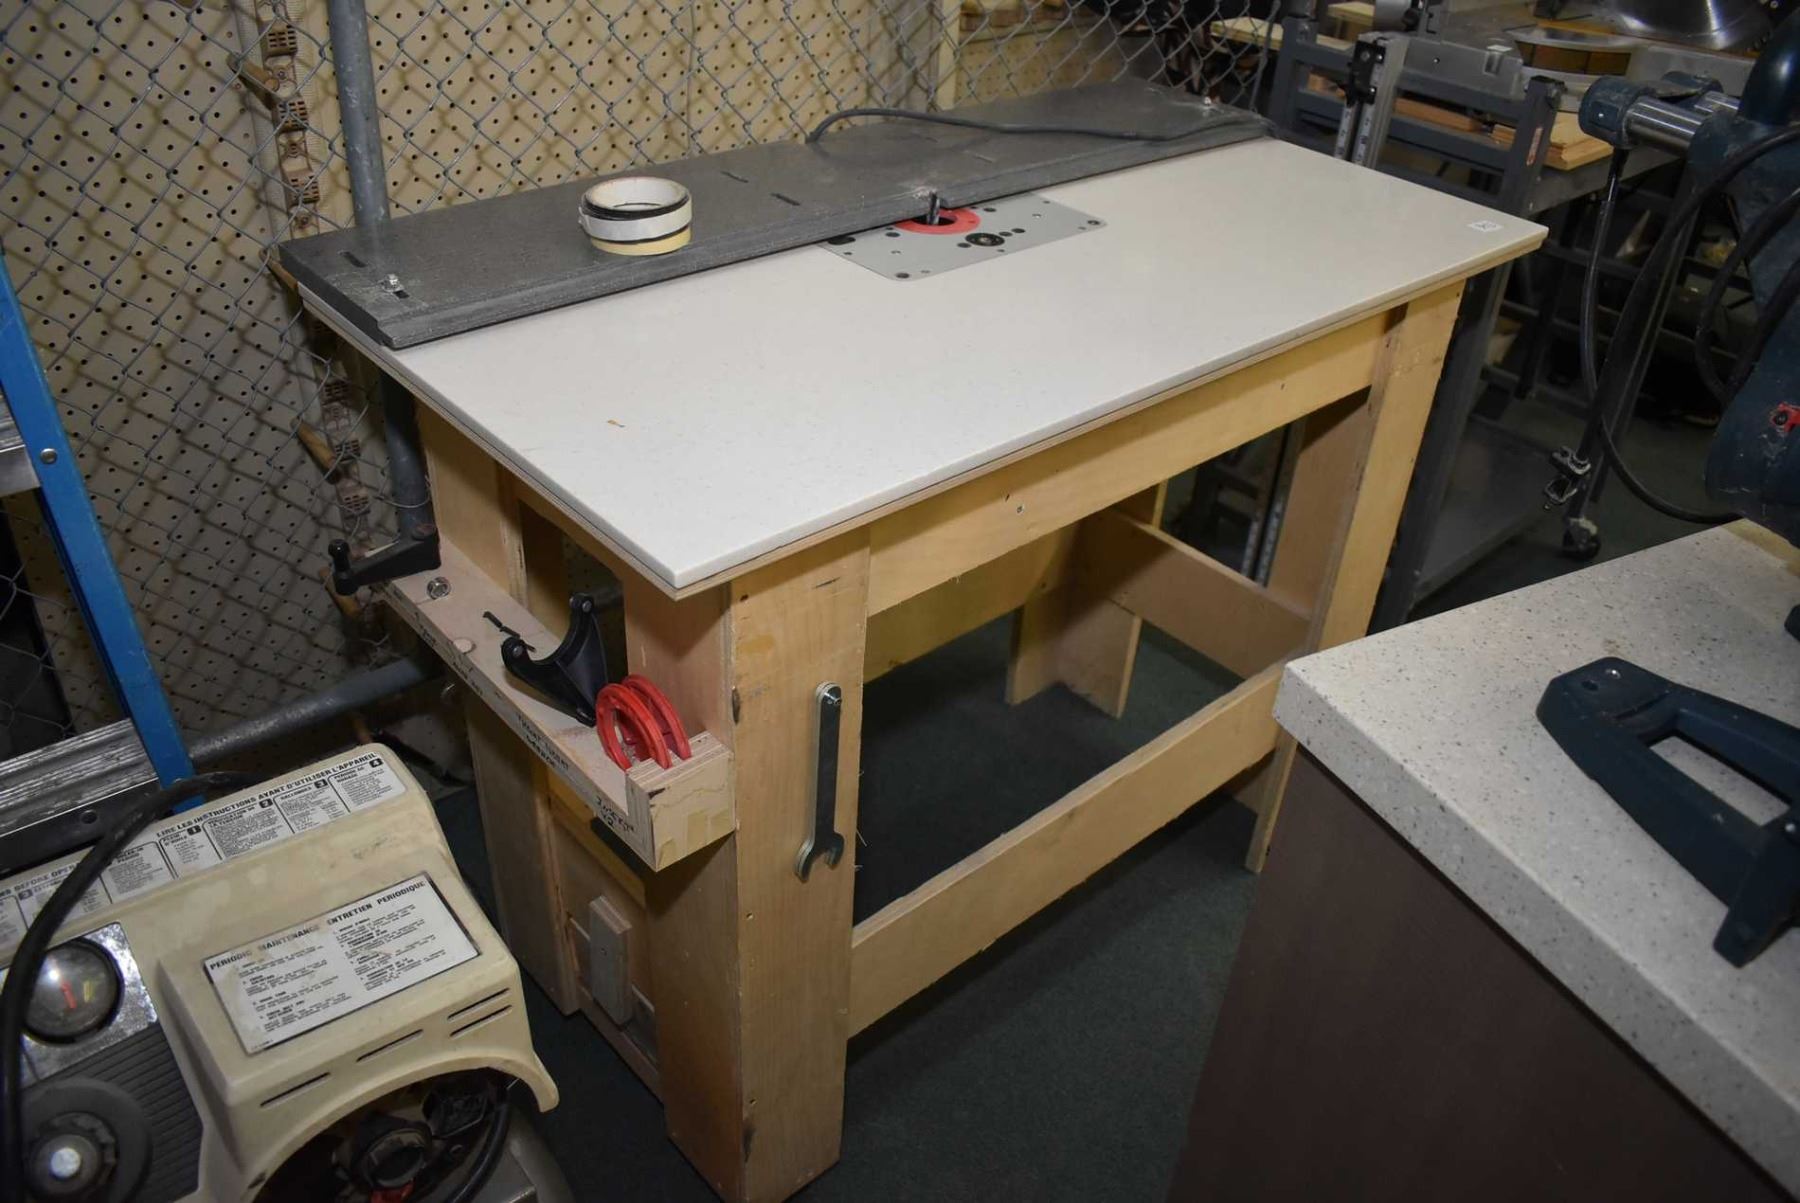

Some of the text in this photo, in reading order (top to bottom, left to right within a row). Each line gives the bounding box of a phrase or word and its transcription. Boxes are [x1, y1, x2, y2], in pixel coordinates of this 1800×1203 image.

[177, 820, 194, 831] LES
[194, 797, 257, 825] INSTRUCTIONS
[258, 786, 285, 800] AYANT
[286, 769, 335, 790] D'UTILISER
[332, 752, 377, 773] L'APPAREIL
[14, 873, 50, 892] BEFORE
[209, 880, 426, 971] PERIODIC MAINTENANCE ENTRETIEN PERIODIQUE
